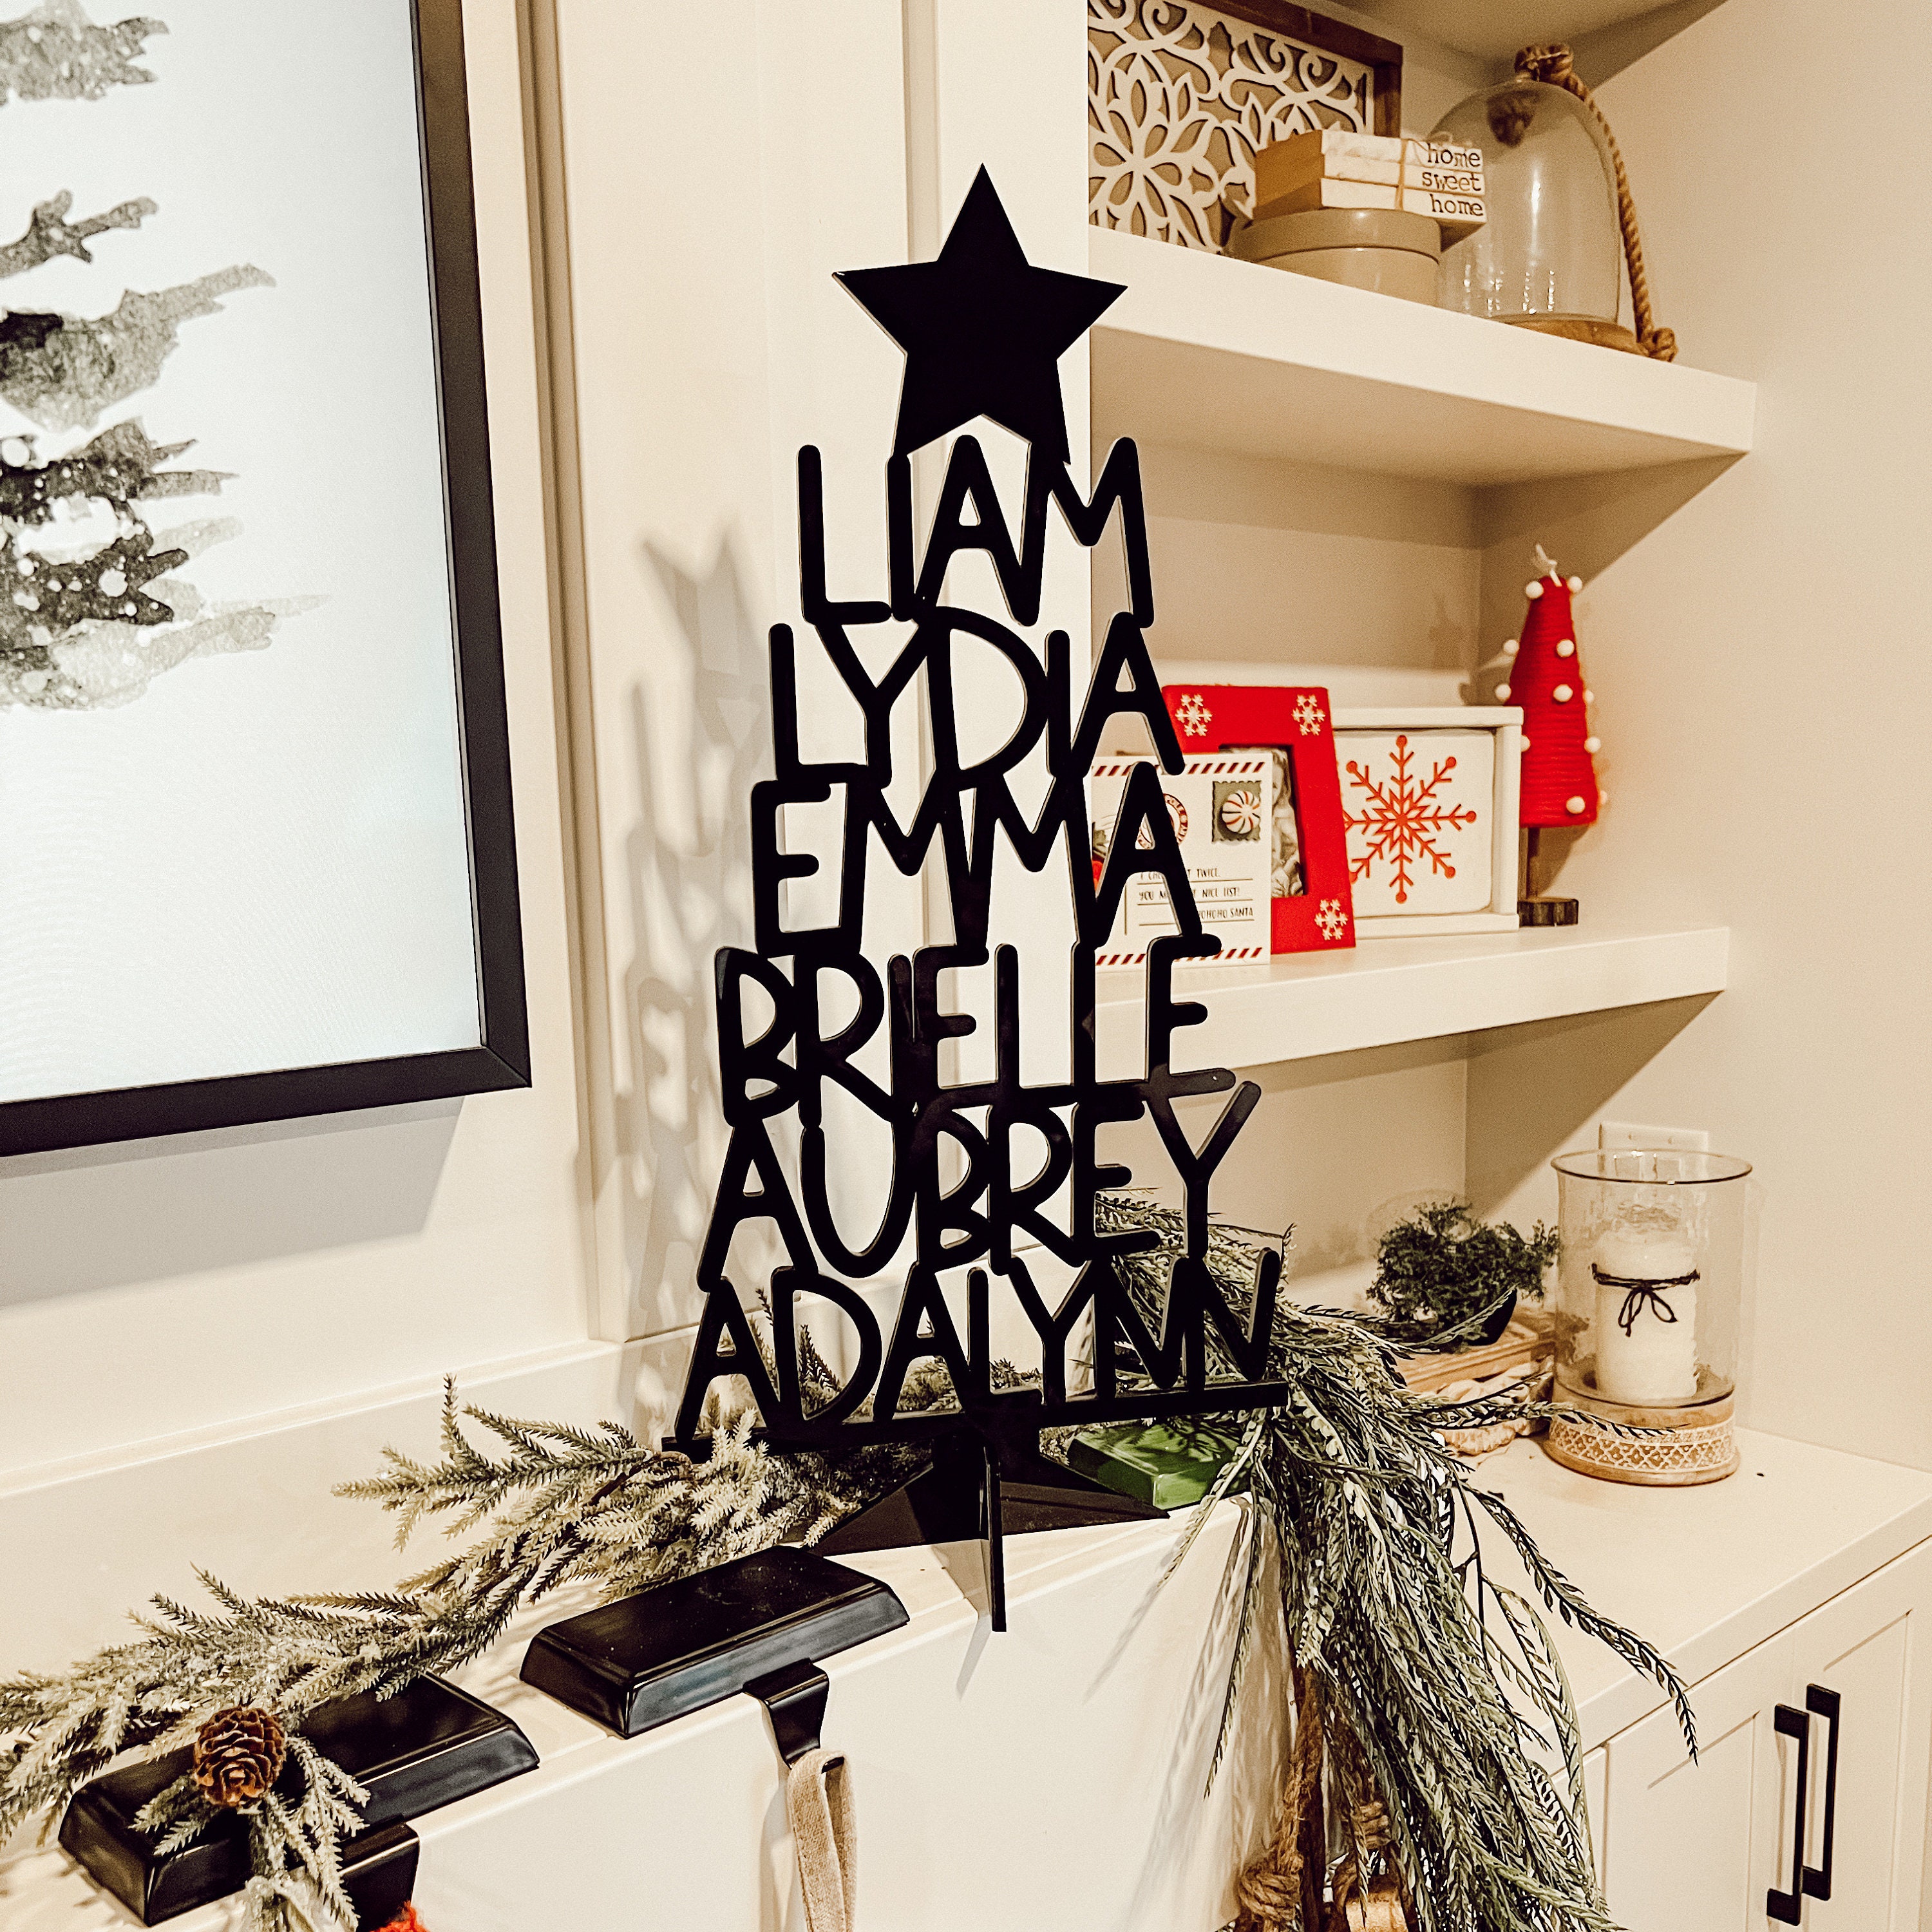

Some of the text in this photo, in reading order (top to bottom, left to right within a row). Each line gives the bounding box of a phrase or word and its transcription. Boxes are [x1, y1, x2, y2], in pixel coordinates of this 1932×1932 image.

[1422, 171, 1482, 192] sweet
[1426, 142, 1481, 168] home
[1430, 193, 1484, 217] home
[797, 435, 1154, 629] LIAM
[769, 605, 1186, 790] LYDIA
[751, 761, 1203, 957] EMMA
[1230, 907, 1253, 918] SANTA
[715, 934, 1236, 1127] BRIELLE
[697, 1079, 1261, 1293] AUBREY
[674, 1247, 1279, 1443] ADALYNN
